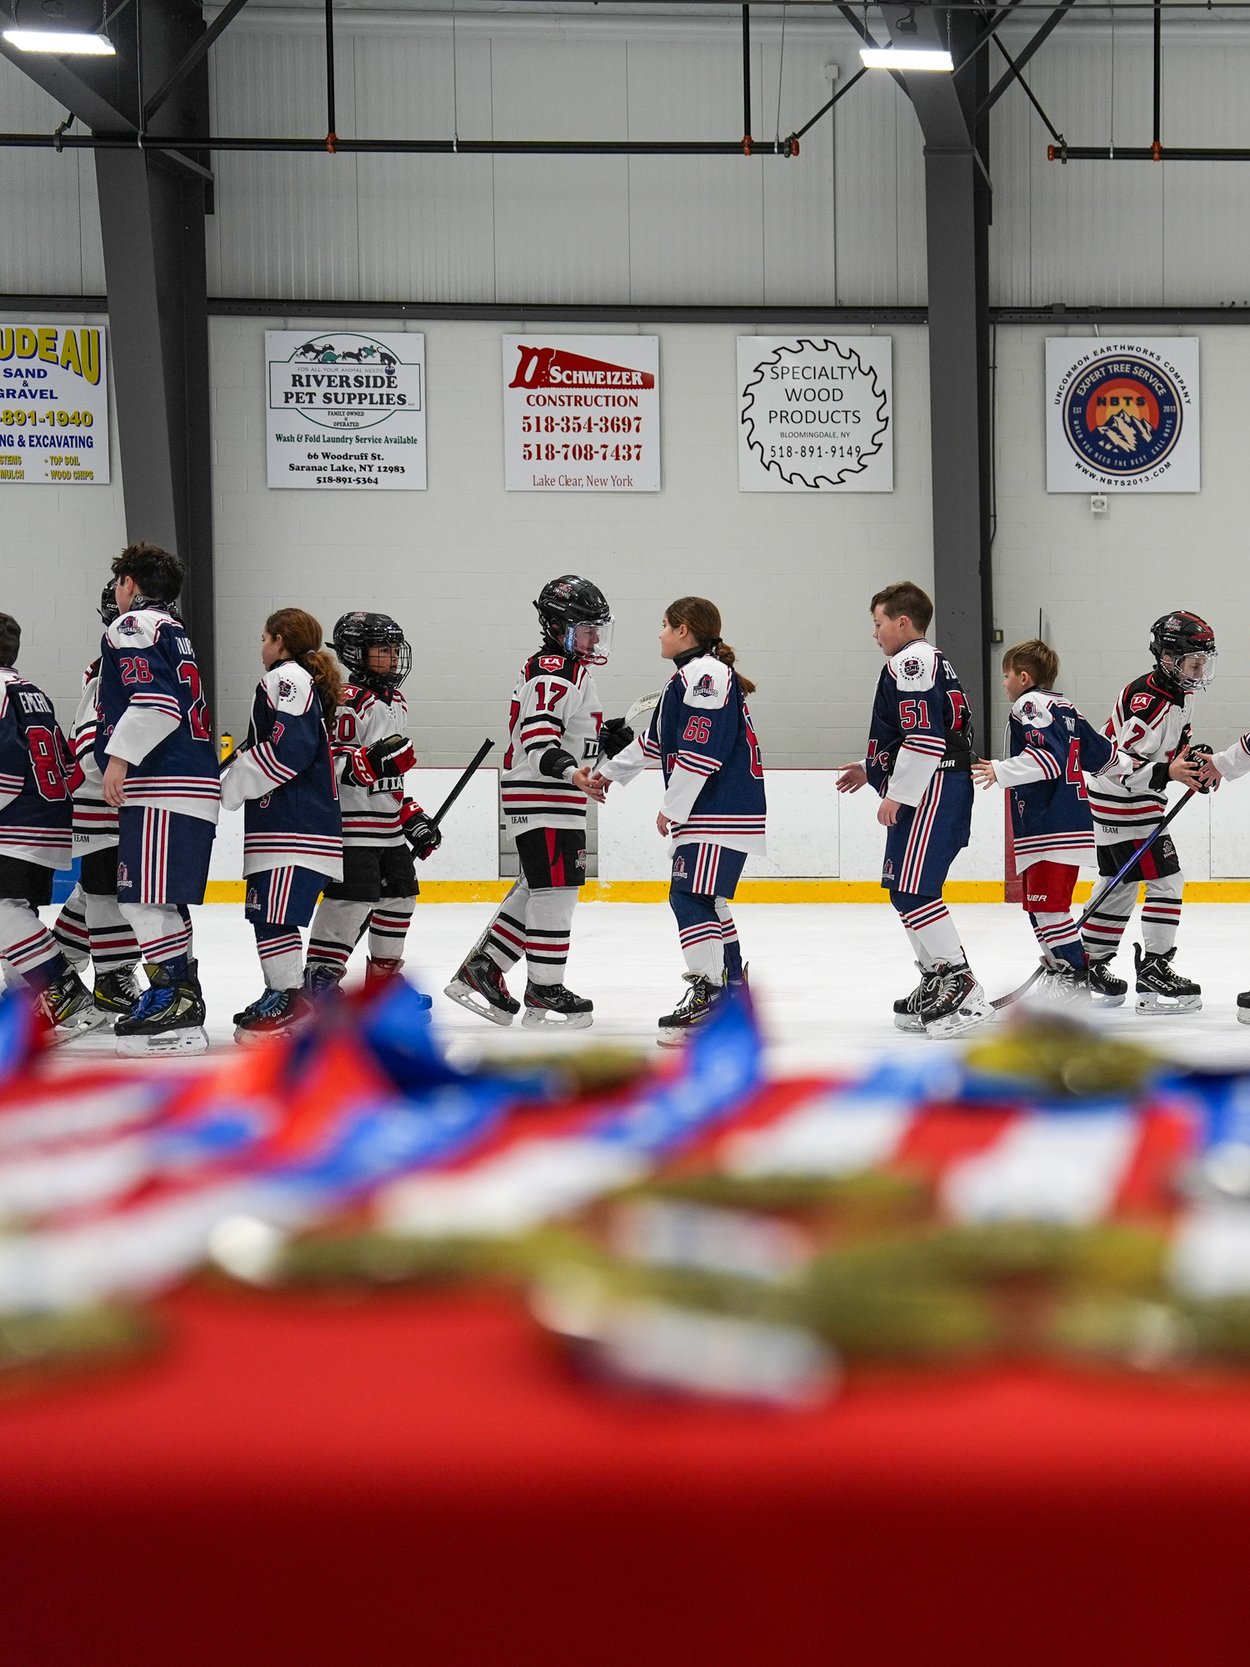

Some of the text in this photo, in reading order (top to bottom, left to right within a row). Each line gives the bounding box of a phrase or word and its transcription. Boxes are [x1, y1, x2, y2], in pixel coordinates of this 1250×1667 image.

[3, 368, 48, 379] SAND
[550, 366, 644, 385] SCHWEIZER
[770, 366, 857, 380] SPECIALTY
[1055, 344, 1191, 405] UNCOMMON EARTHWORKS COMPANY
[1077, 364, 1166, 396] EXPERT TREE SERVICE
[292, 374, 398, 388] RIVERSIDE
[284, 392, 406, 406] PET SUPPLIES
[527, 394, 638, 407] CONSTRUCTION
[785, 388, 843, 402] WOOD
[1096, 397, 1145, 406] NBTS
[769, 410, 861, 424] PRODUCTS
[522, 416, 642, 433] 518-354-3697
[17, 435, 25, 447] &
[29, 435, 94, 448] EXCAVATING
[276, 434, 418, 445] Wash & Fold Laundry Service Available
[321, 452, 368, 460] Woodruff
[523, 444, 642, 461] 518-708-7437
[770, 446, 861, 458] 518-891-9149
[50, 456, 63, 465] TOP
[65, 456, 80, 466] SOIL
[51, 470, 71, 480] WOOD
[74, 471, 94, 481] CHIPS
[289, 464, 328, 472] Saranac
[330, 464, 356, 473] Lake,
[1074, 461, 1172, 486] WWW.NBTS2013.COM
[316, 476, 378, 485] 518-891-5364
[533, 475, 633, 488] Lake Clear, New York
[120, 656, 153, 685] 28
[535, 682, 568, 712] 17
[899, 700, 931, 729] 51
[683, 715, 712, 744] 66
[25, 725, 73, 802] 8
[511, 816, 529, 824] TEAM
[1102, 826, 1119, 834] TEAM
[74, 834, 90, 843] TEAM
[1147, 975, 1173, 991] CCM
